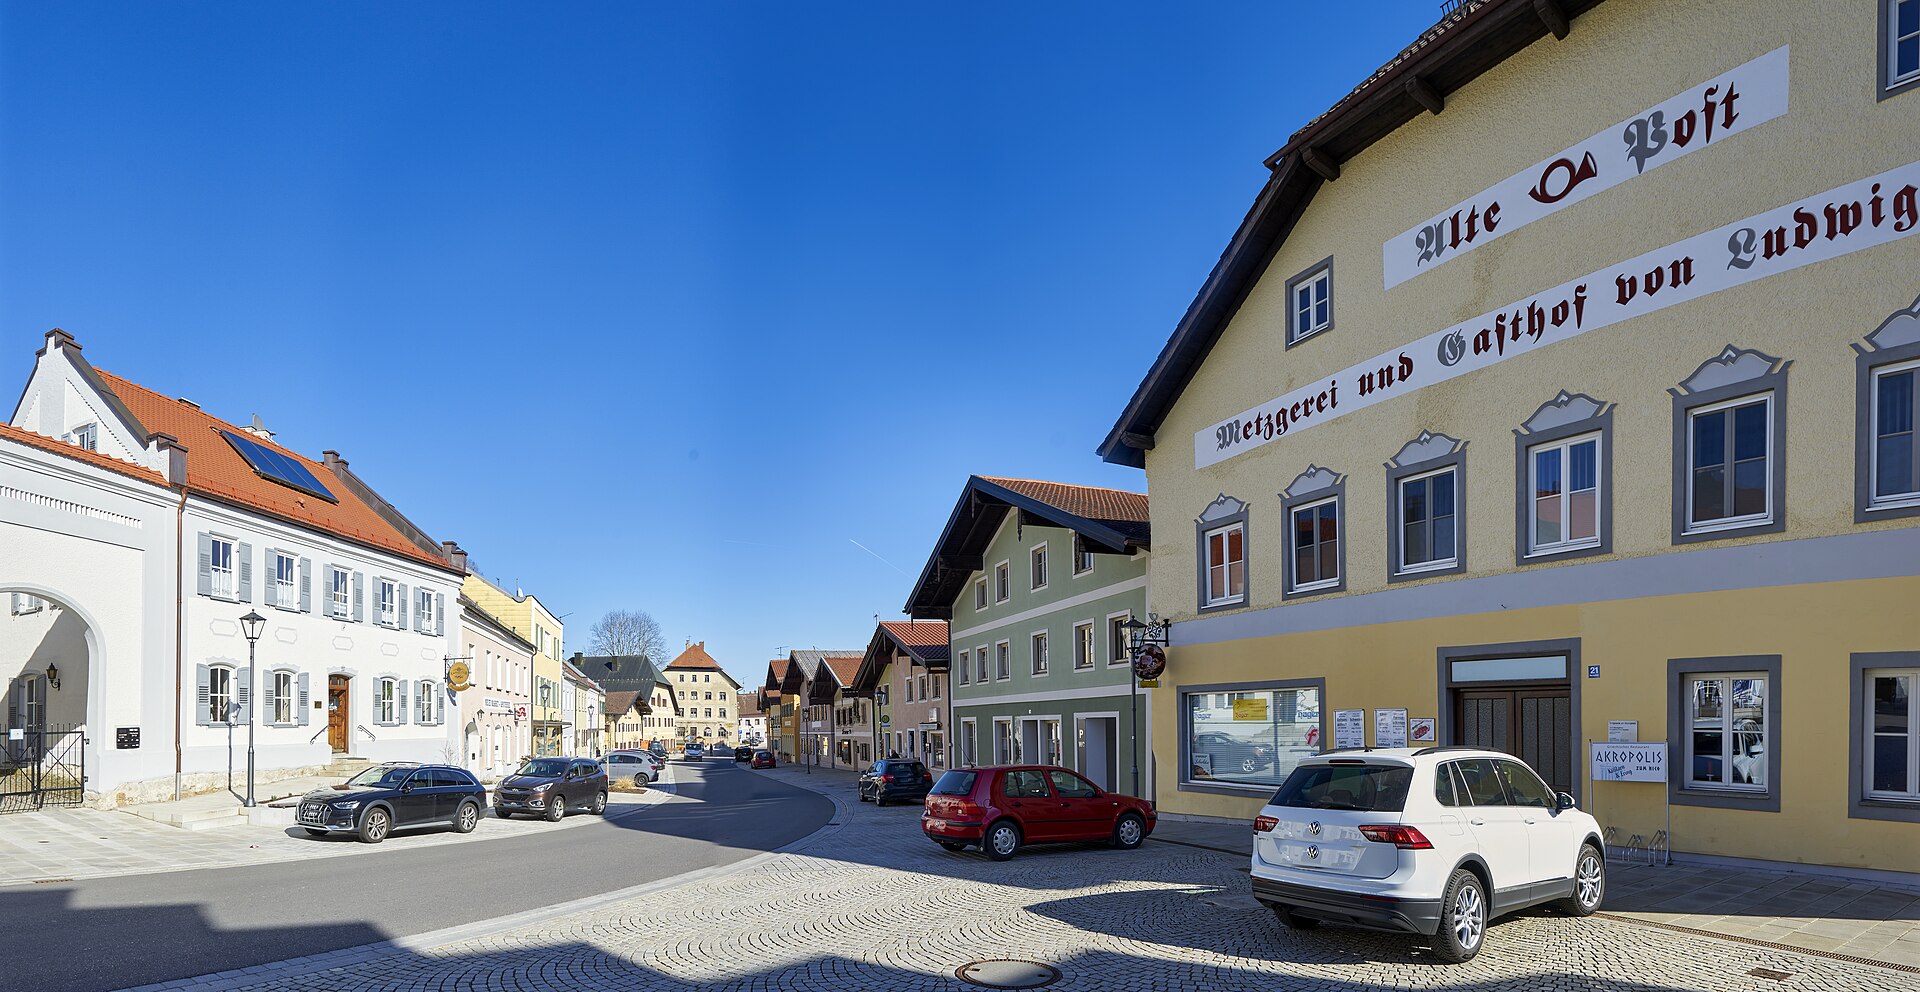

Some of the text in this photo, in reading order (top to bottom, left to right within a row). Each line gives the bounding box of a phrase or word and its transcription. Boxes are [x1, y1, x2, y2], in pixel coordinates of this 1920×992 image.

[1416, 201, 1502, 267] Alte
[1216, 379, 1339, 452] Metzgerei
[1357, 351, 1414, 397] und
[1615, 256, 1696, 306] von
[1726, 182, 1919, 271] Ludwig
[1590, 666, 1599, 674] 21
[1595, 750, 1663, 763] AKROPOLIS
